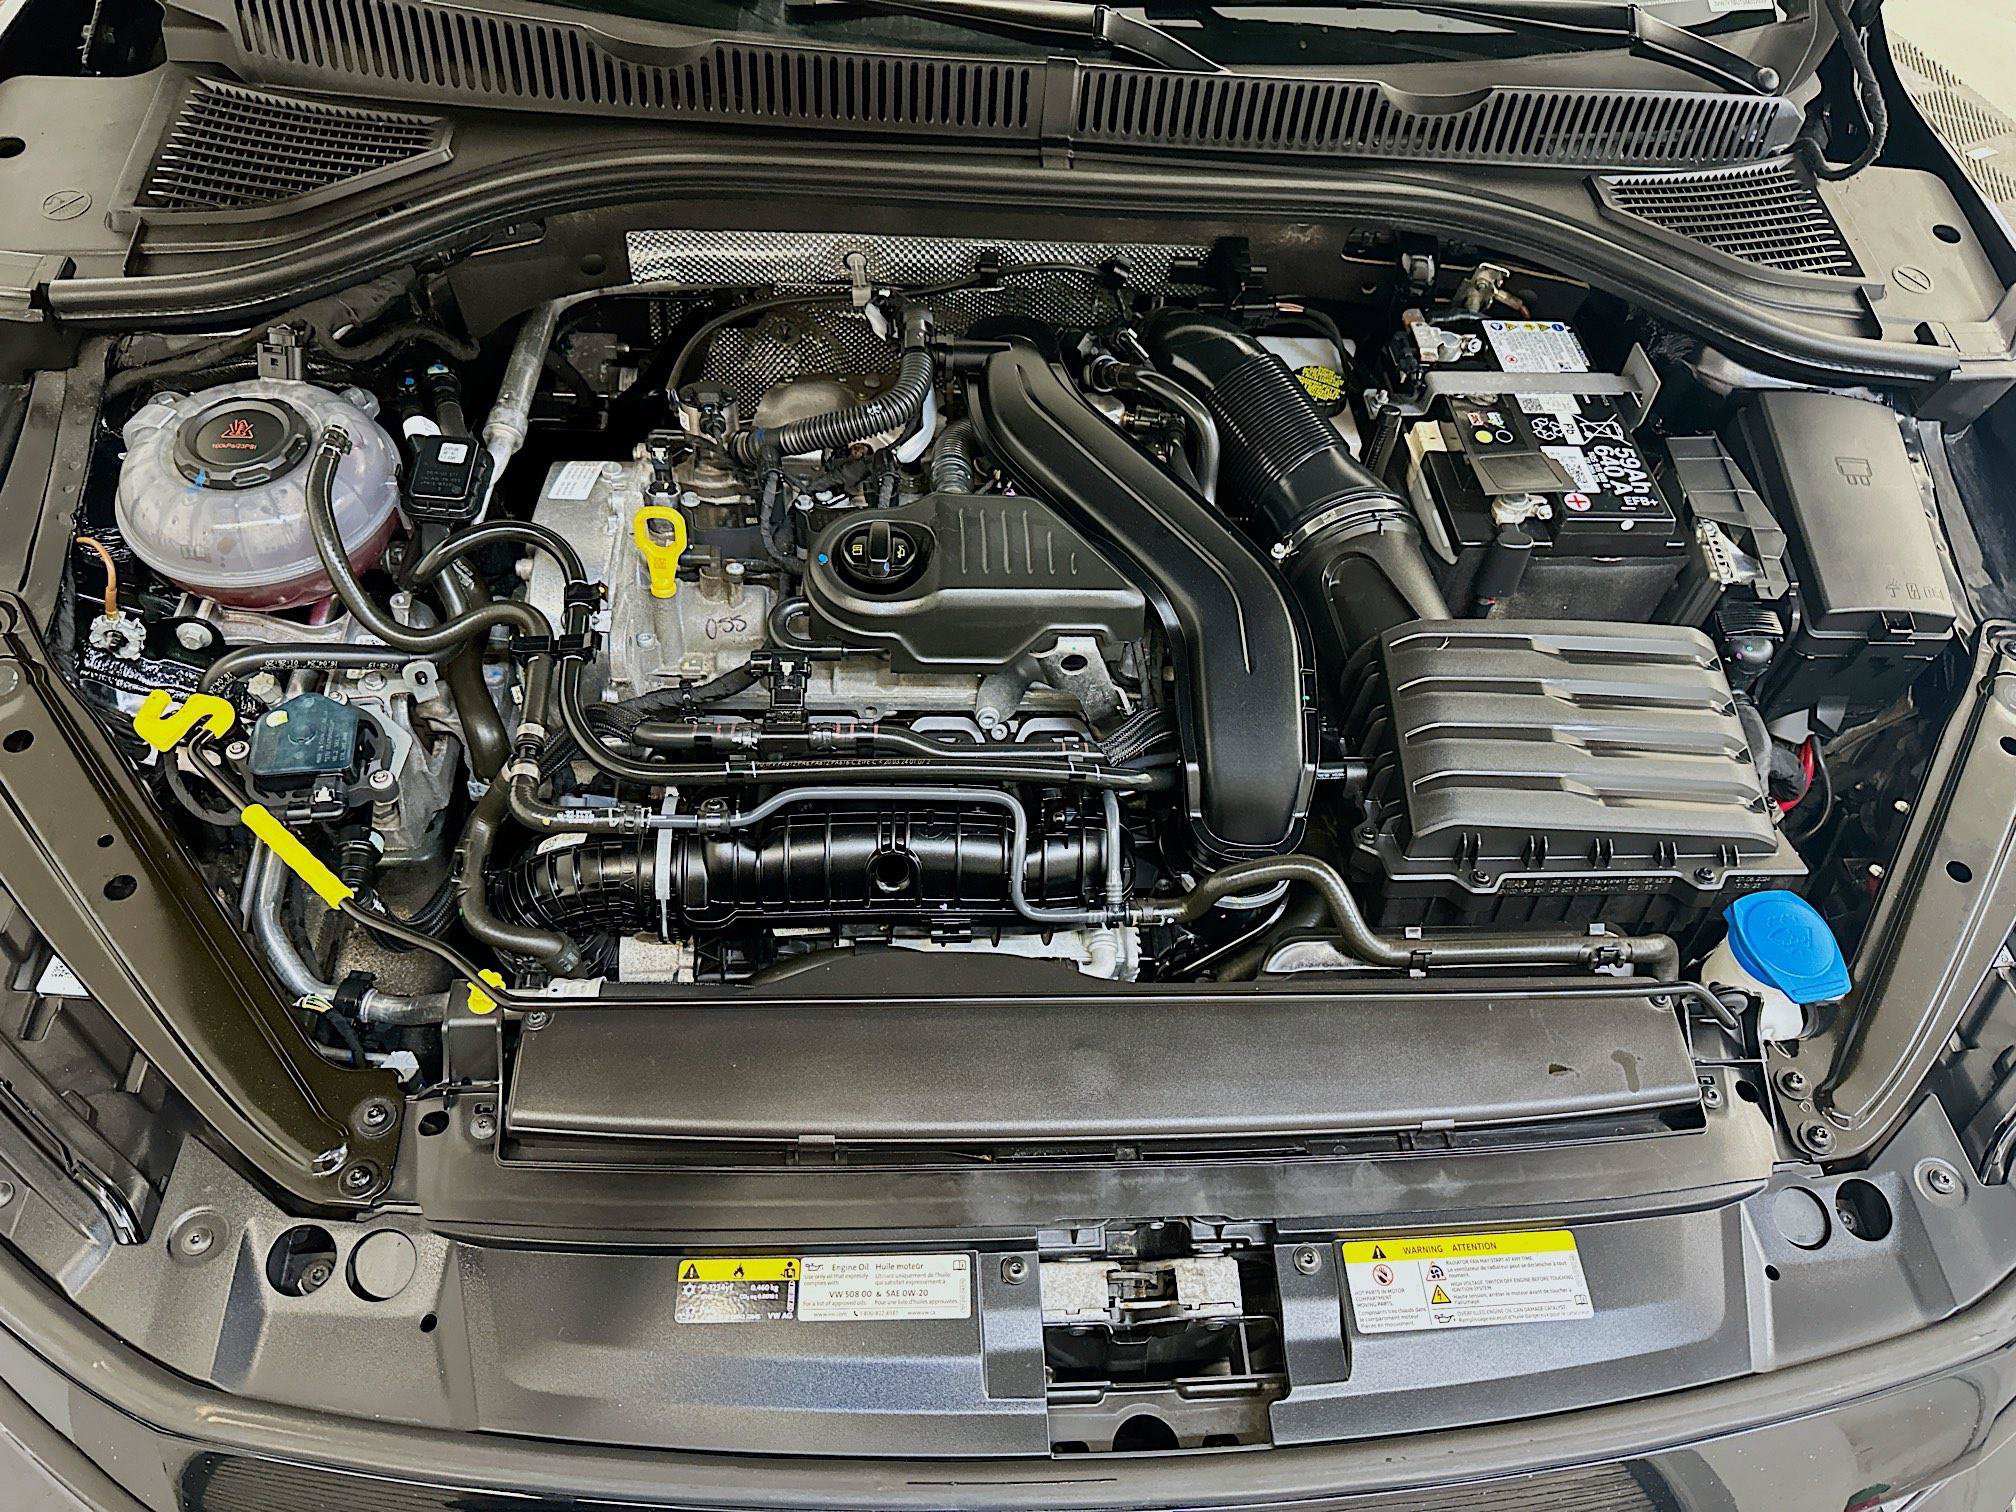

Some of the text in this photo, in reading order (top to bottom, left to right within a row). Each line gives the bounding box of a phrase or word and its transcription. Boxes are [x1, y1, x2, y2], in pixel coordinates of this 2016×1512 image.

[1564, 423, 1575, 434] Pb
[1594, 445, 1625, 478] 640
[1610, 480, 1634, 496] A
[1614, 447, 1652, 494] 59Ah
[1623, 496, 1658, 506] EFB+
[706, 614, 748, 640] 055
[1403, 1242, 1497, 1254] WARNING ATTENTION
[832, 1263, 857, 1272] Engine
